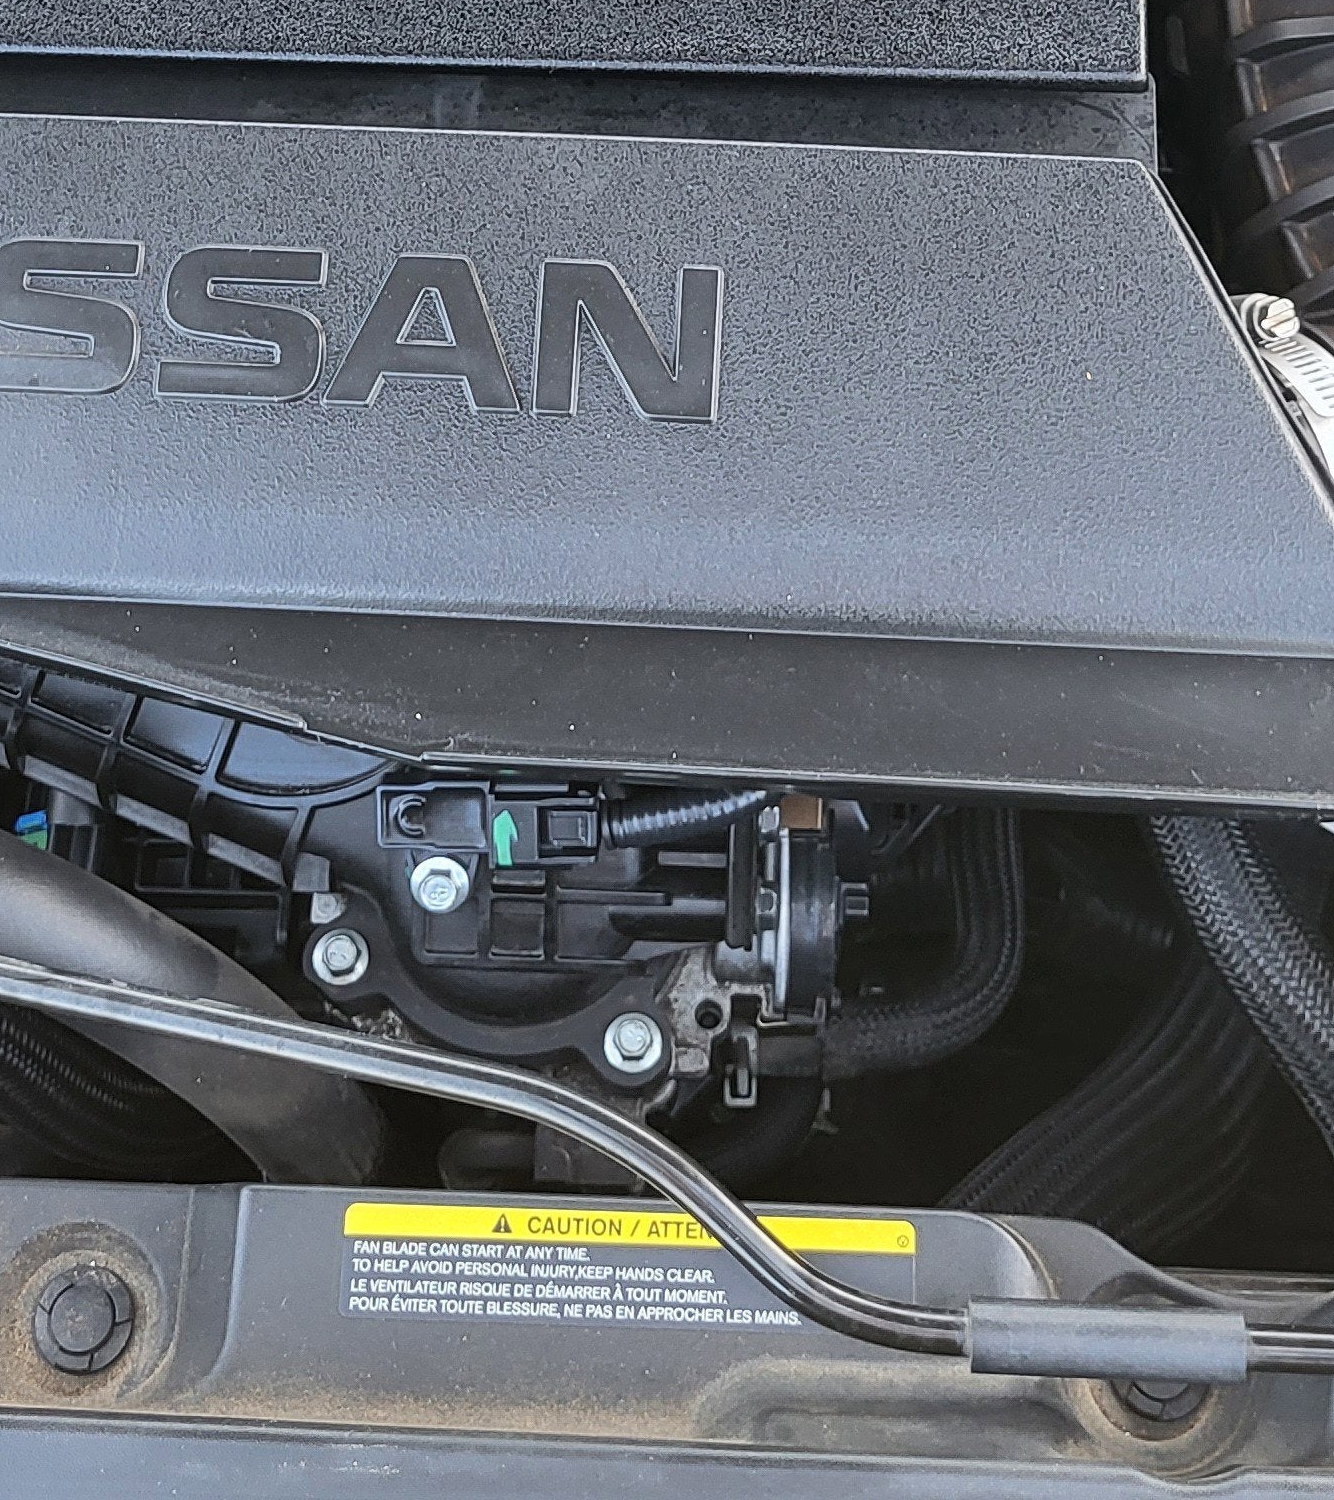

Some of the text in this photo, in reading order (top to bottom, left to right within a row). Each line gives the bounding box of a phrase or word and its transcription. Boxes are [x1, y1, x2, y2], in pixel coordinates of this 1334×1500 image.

[527, 1216, 623, 1237] CAUTION
[353, 1240, 591, 1261] FAN BLADE CAN START AT ANY TIME.
[352, 1258, 715, 1284] TO HELP AVOID PERSONAL INJURY,KEEP HANDS CLEAR.
[350, 1278, 728, 1304] LE VENTILATEUR RISQUE DE DÉMARRER À TOUT MOMENT.
[349, 1294, 803, 1326] POUR ÉVITER TOUTE BLESSURE, NE PAS EN APPROCHER LES MAINS.
